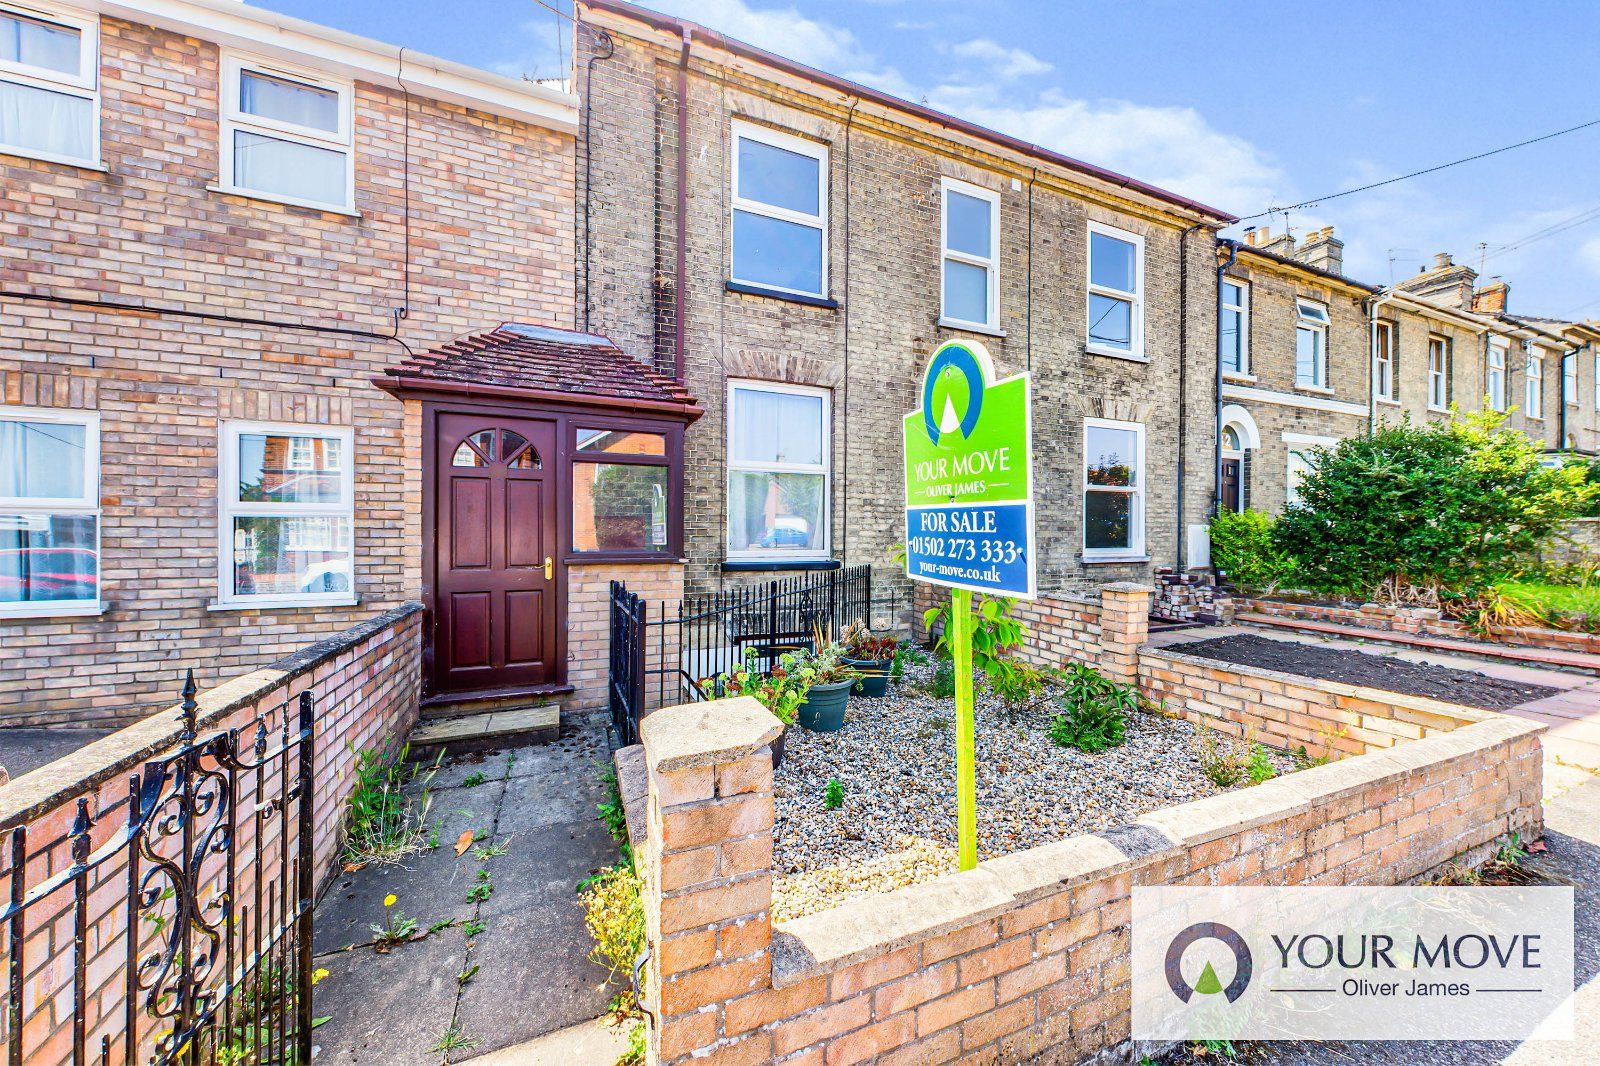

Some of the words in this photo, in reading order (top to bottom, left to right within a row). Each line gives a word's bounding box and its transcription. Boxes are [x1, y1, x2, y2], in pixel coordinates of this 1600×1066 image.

[914, 458, 948, 482] YOUR
[953, 447, 1010, 477] MOVE
[926, 484, 952, 497] OLIVER
[954, 480, 986, 497] JAMES
[921, 512, 948, 532] FOR
[951, 511, 997, 533] SALE
[912, 536, 945, 557] 01502
[947, 538, 976, 561] 273
[980, 540, 1017, 564] 333
[919, 561, 1001, 582] your-move.co.uk
